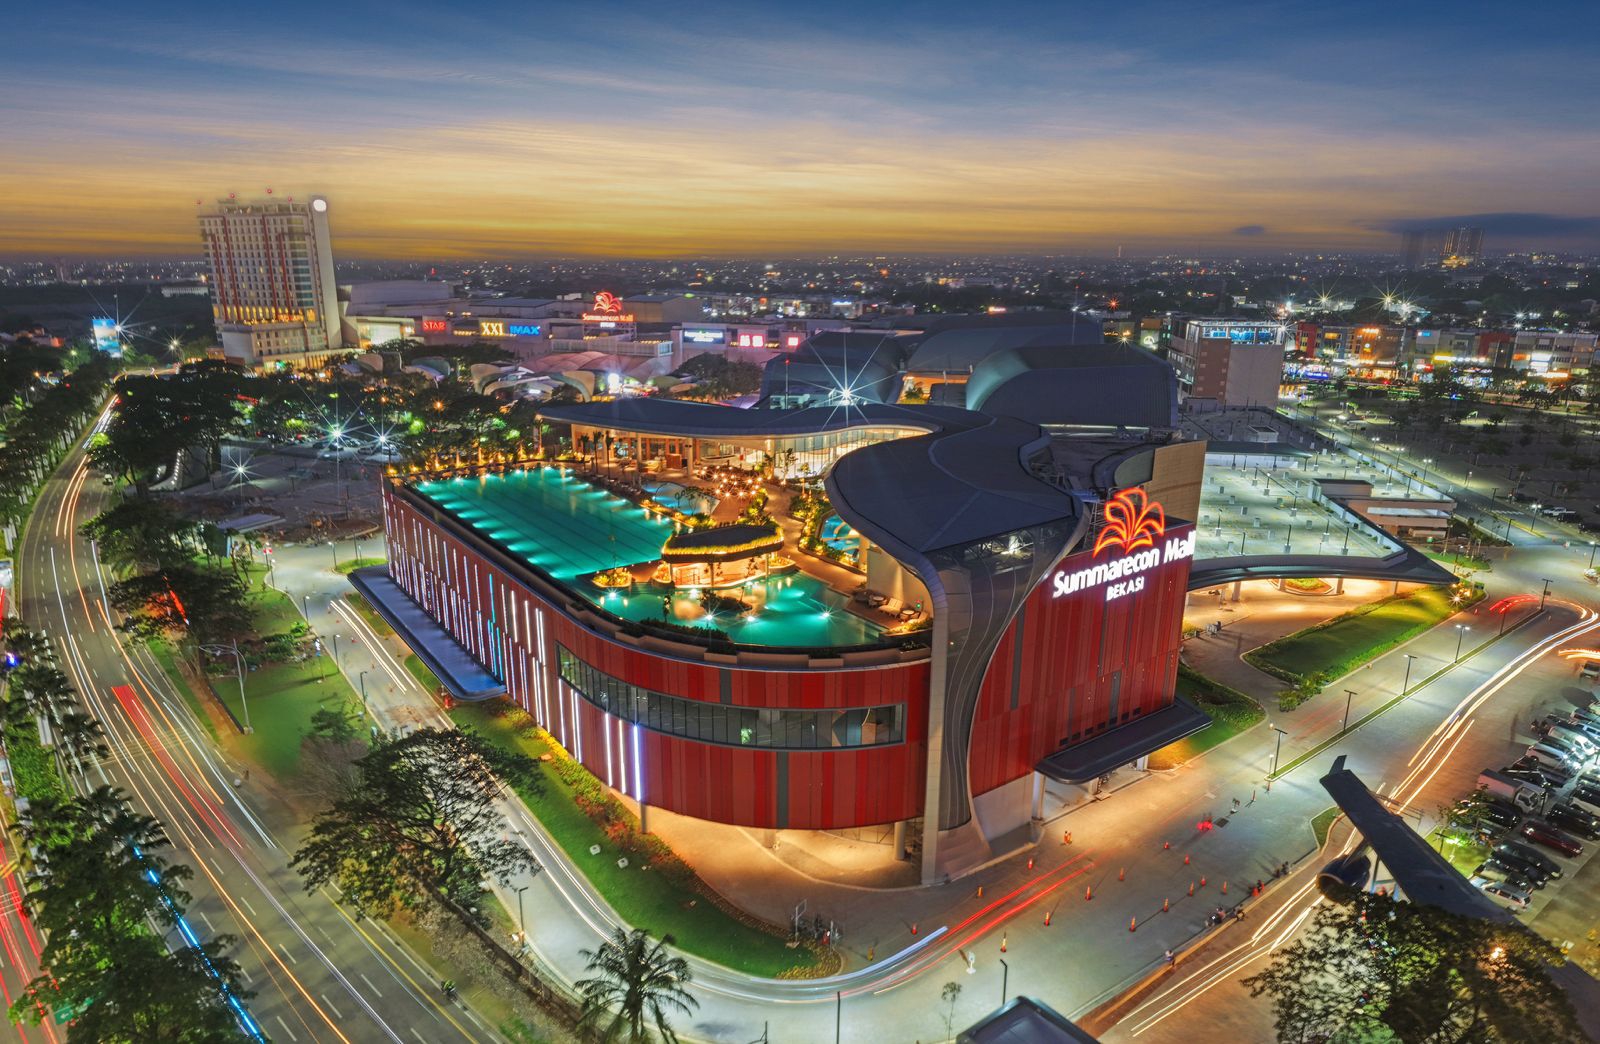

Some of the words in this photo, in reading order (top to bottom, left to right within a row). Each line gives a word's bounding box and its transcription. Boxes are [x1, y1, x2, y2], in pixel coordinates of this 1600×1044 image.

[422, 321, 446, 331] STAR
[481, 322, 504, 336] XXI
[509, 325, 540, 335] IMAX
[1054, 549, 1160, 598] Summarecon
[1164, 530, 1196, 564] Mall
[1106, 576, 1145, 601] BEKASI
